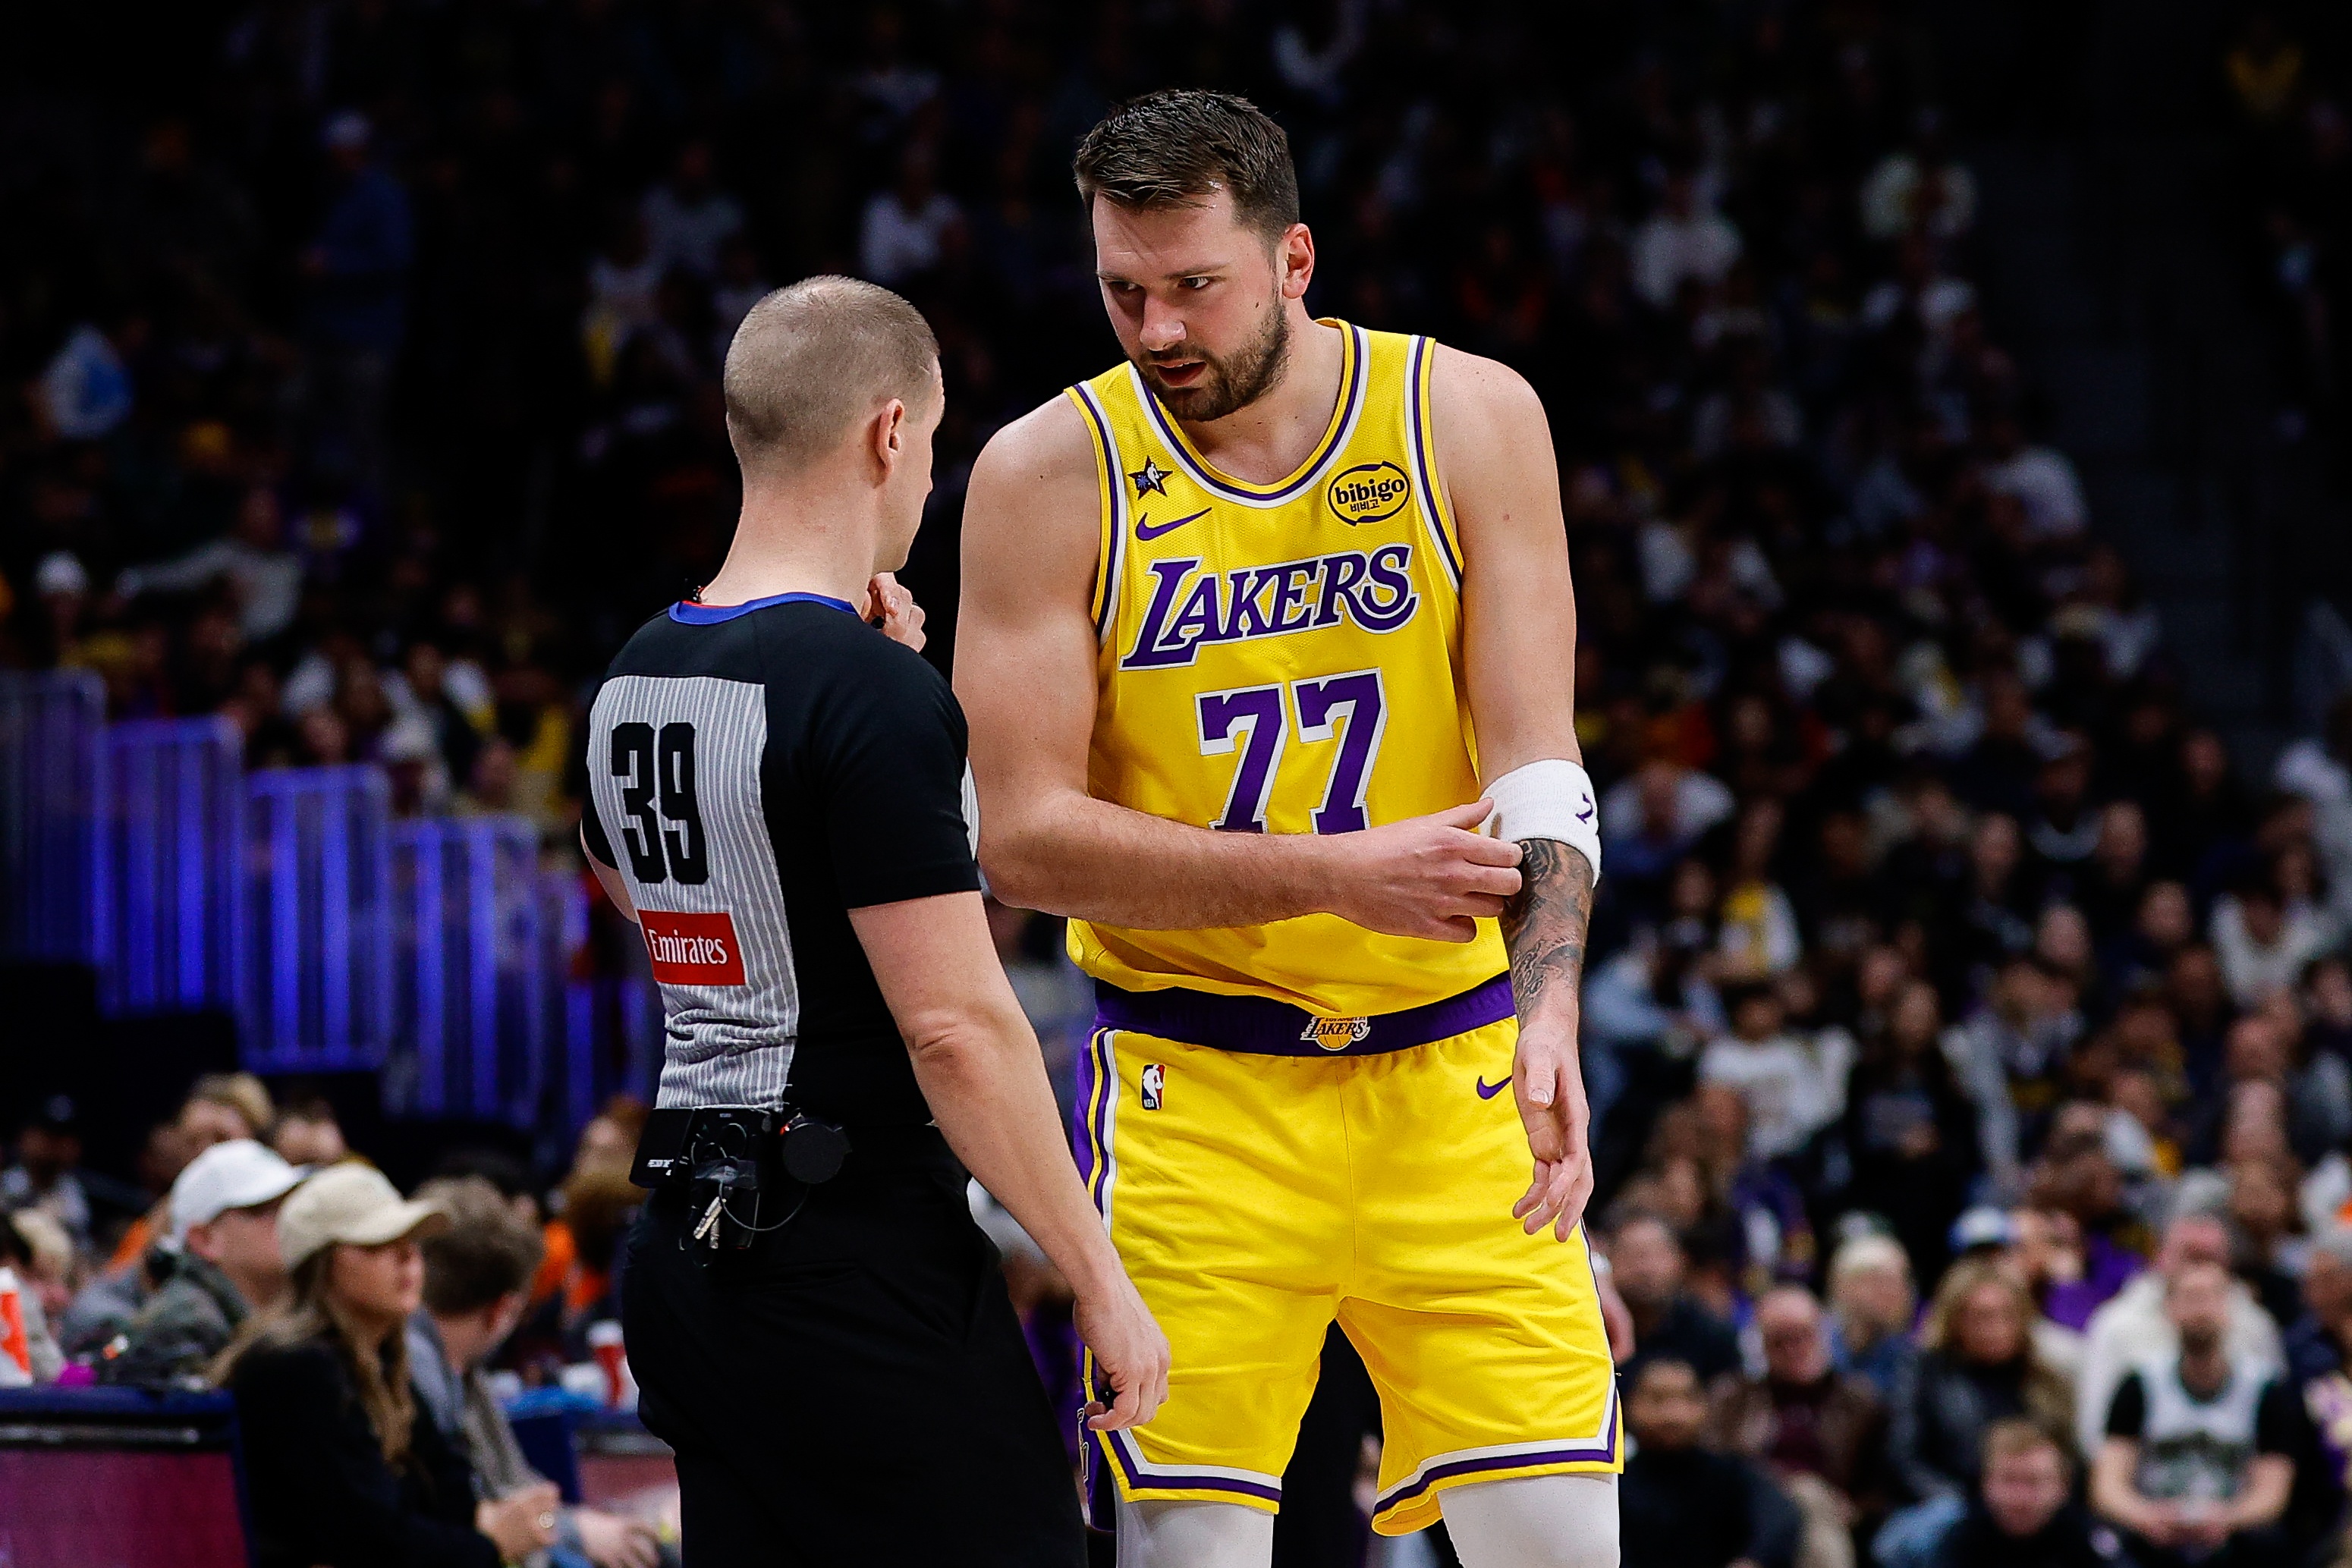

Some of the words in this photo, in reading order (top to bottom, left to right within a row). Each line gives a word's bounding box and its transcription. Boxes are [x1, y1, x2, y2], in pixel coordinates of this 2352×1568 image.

[1335, 478, 1405, 504] bibigo
[1350, 499, 1380, 512] 비비고
[1118, 543, 1420, 671] LAKERS
[1194, 667, 1388, 834] 77
[612, 722, 709, 885] 39
[647, 929, 728, 964] Emirates
[1300, 1017, 1369, 1039] LAKERS
